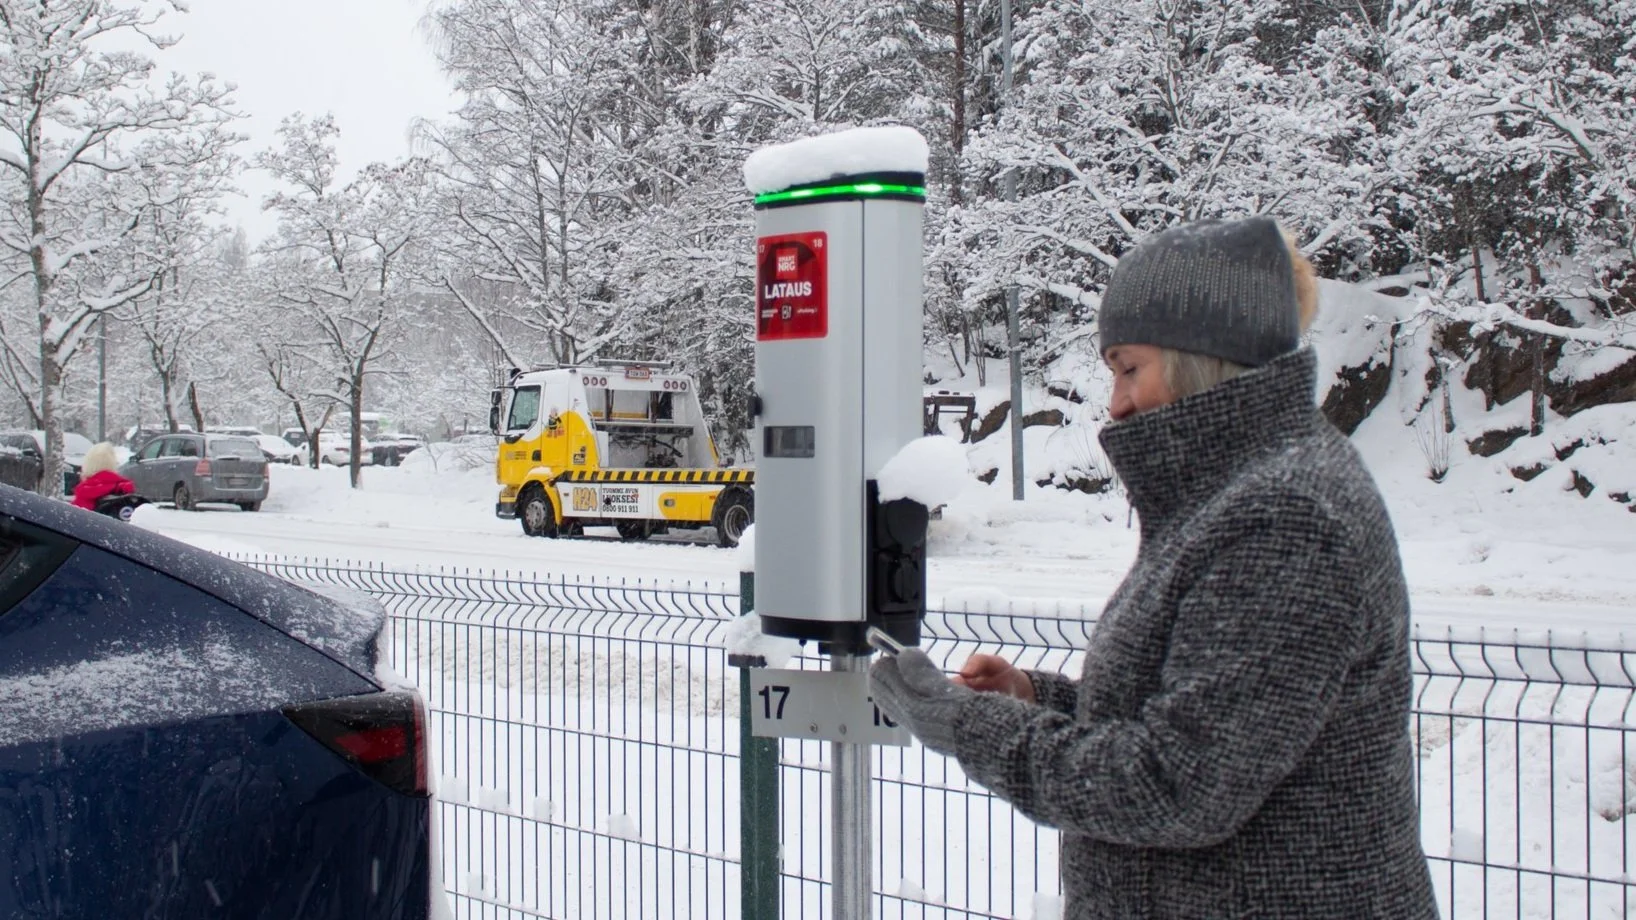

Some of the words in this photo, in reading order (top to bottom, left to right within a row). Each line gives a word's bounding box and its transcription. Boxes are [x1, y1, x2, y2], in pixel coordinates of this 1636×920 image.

[813, 238, 823, 248] 18
[777, 261, 796, 272] NRG
[765, 281, 812, 300] LATAUS
[573, 487, 598, 511] H24
[602, 504, 616, 512] 0800
[618, 505, 627, 513] 911
[628, 505, 639, 513] 911
[758, 685, 790, 719] 17
